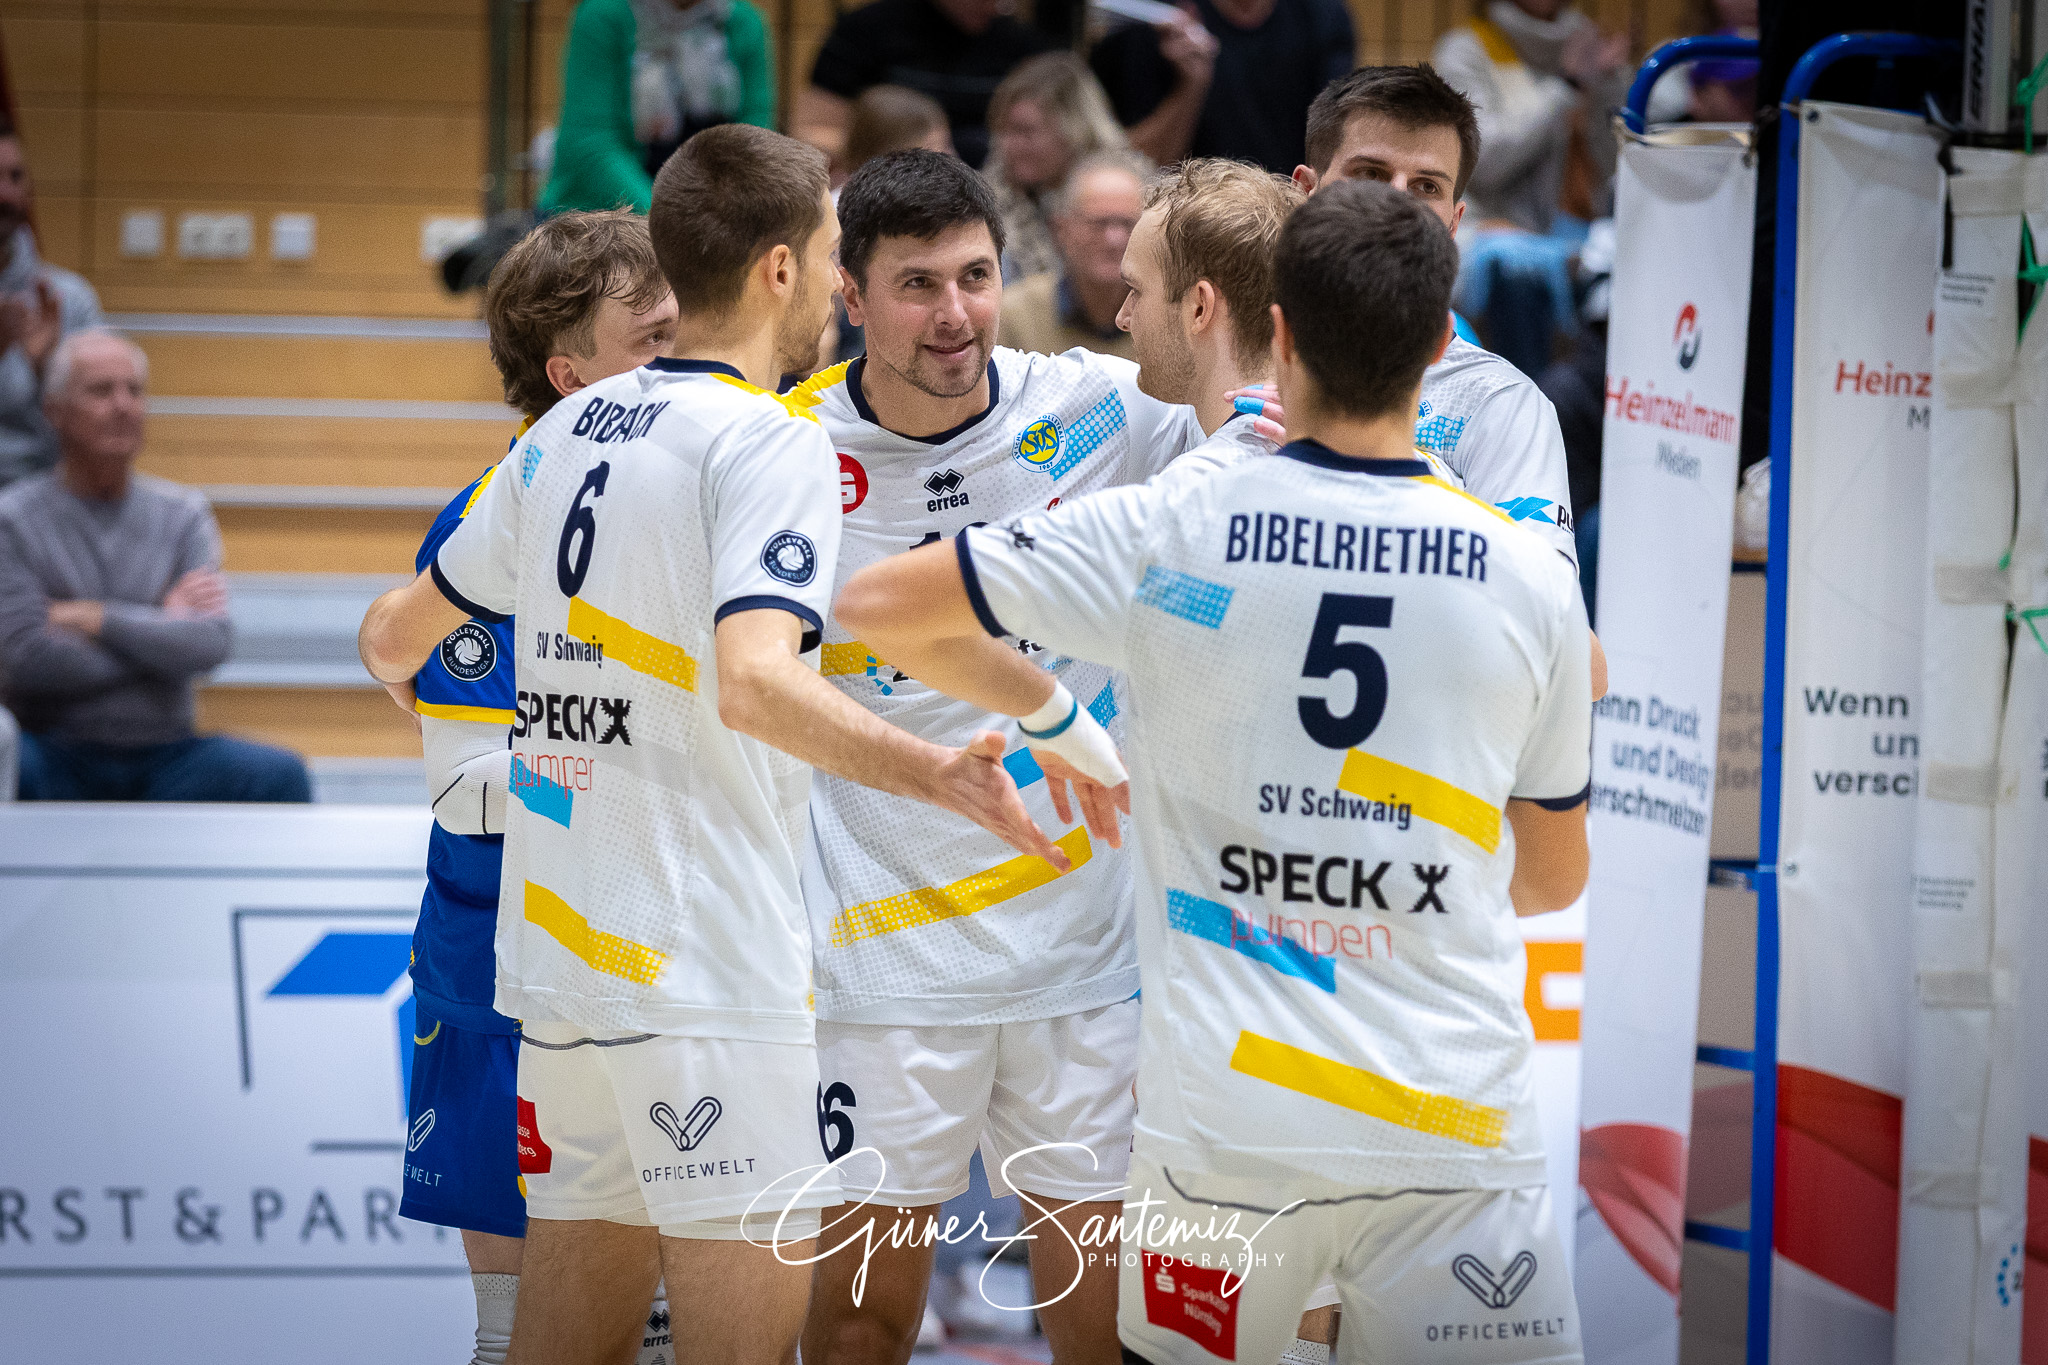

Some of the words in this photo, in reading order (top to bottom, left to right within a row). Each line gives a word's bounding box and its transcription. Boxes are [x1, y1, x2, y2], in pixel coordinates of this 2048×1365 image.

[1835, 360, 1932, 398] Heinz
[927, 492, 970, 513] errea
[557, 461, 610, 598] 6
[1226, 512, 1488, 582] BIBELRIETHER
[446, 627, 488, 649] VOLLEYBALL
[537, 631, 549, 659] SV
[555, 632, 604, 669] Shwaig
[446, 656, 490, 676] BUNDESLIGA
[1298, 592, 1394, 750] 5
[513, 690, 598, 743] SPECK
[1594, 695, 1640, 723] enn
[1804, 687, 1908, 717] Wenn
[1612, 743, 1661, 775] und
[1260, 784, 1291, 814] SV
[1301, 786, 1413, 831] Schwaig
[1220, 844, 1391, 911] SPECK
[642, 1158, 755, 1183] OFFICEWELT
[173, 1187, 222, 1244] &
[1426, 1318, 1566, 1341] OFFICEWELT
